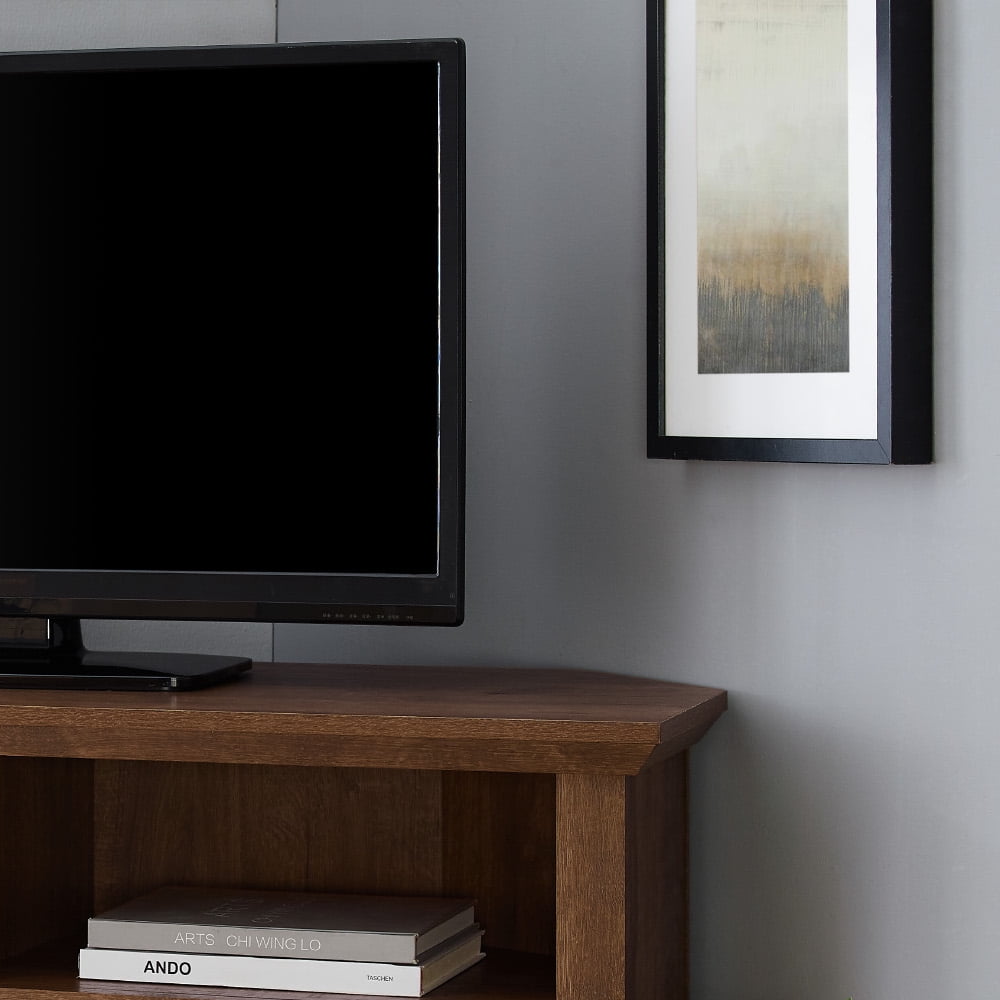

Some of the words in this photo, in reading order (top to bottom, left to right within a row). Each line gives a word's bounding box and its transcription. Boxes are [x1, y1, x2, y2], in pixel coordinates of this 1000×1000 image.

[174, 932, 215, 946] ARTS
[226, 934, 252, 948] CHI
[255, 936, 297, 950] WING
[300, 939, 321, 951] LO
[143, 960, 192, 976] ANDO
[367, 974, 394, 982] TASCHEN
